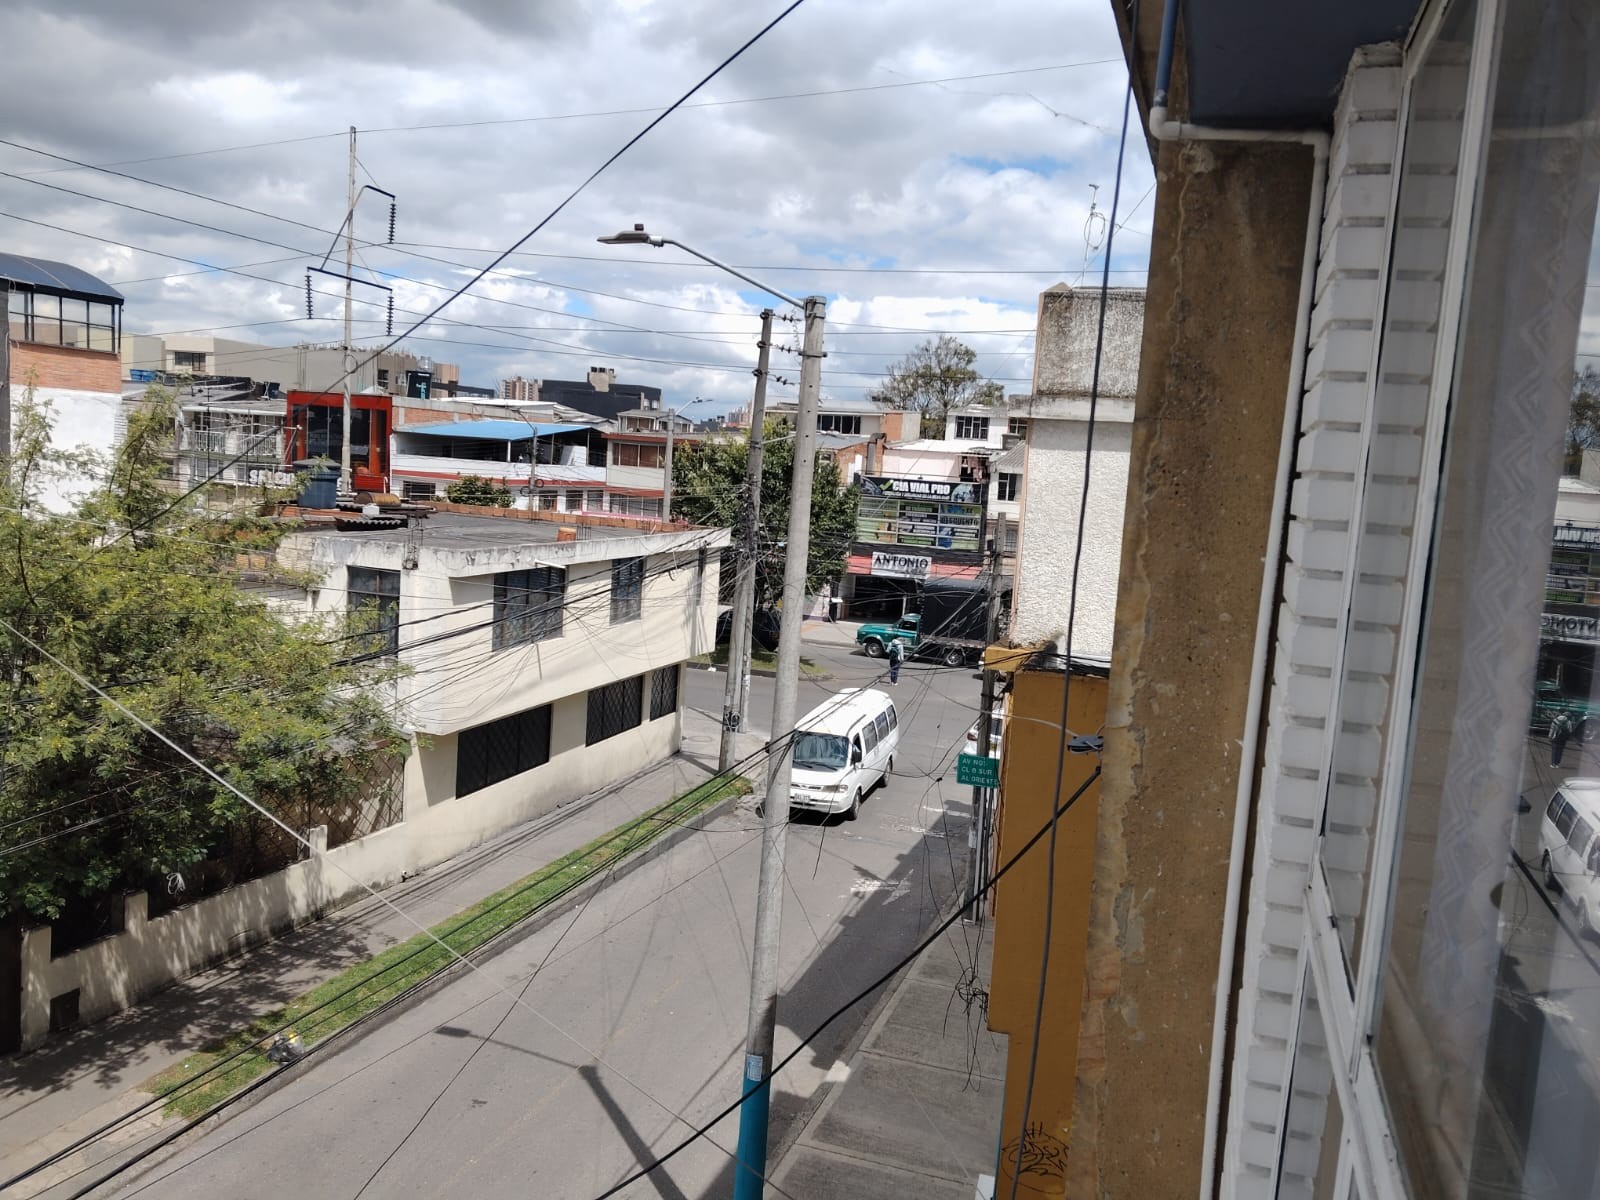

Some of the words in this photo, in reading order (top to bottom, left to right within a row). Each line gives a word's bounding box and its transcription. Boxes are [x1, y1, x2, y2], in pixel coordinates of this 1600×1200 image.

[909, 481, 930, 494] VIAL
[931, 483, 951, 495] PRO
[874, 554, 928, 569] ANTONIO
[978, 768, 993, 776] SUR
[971, 775, 998, 785] ORIENTE
